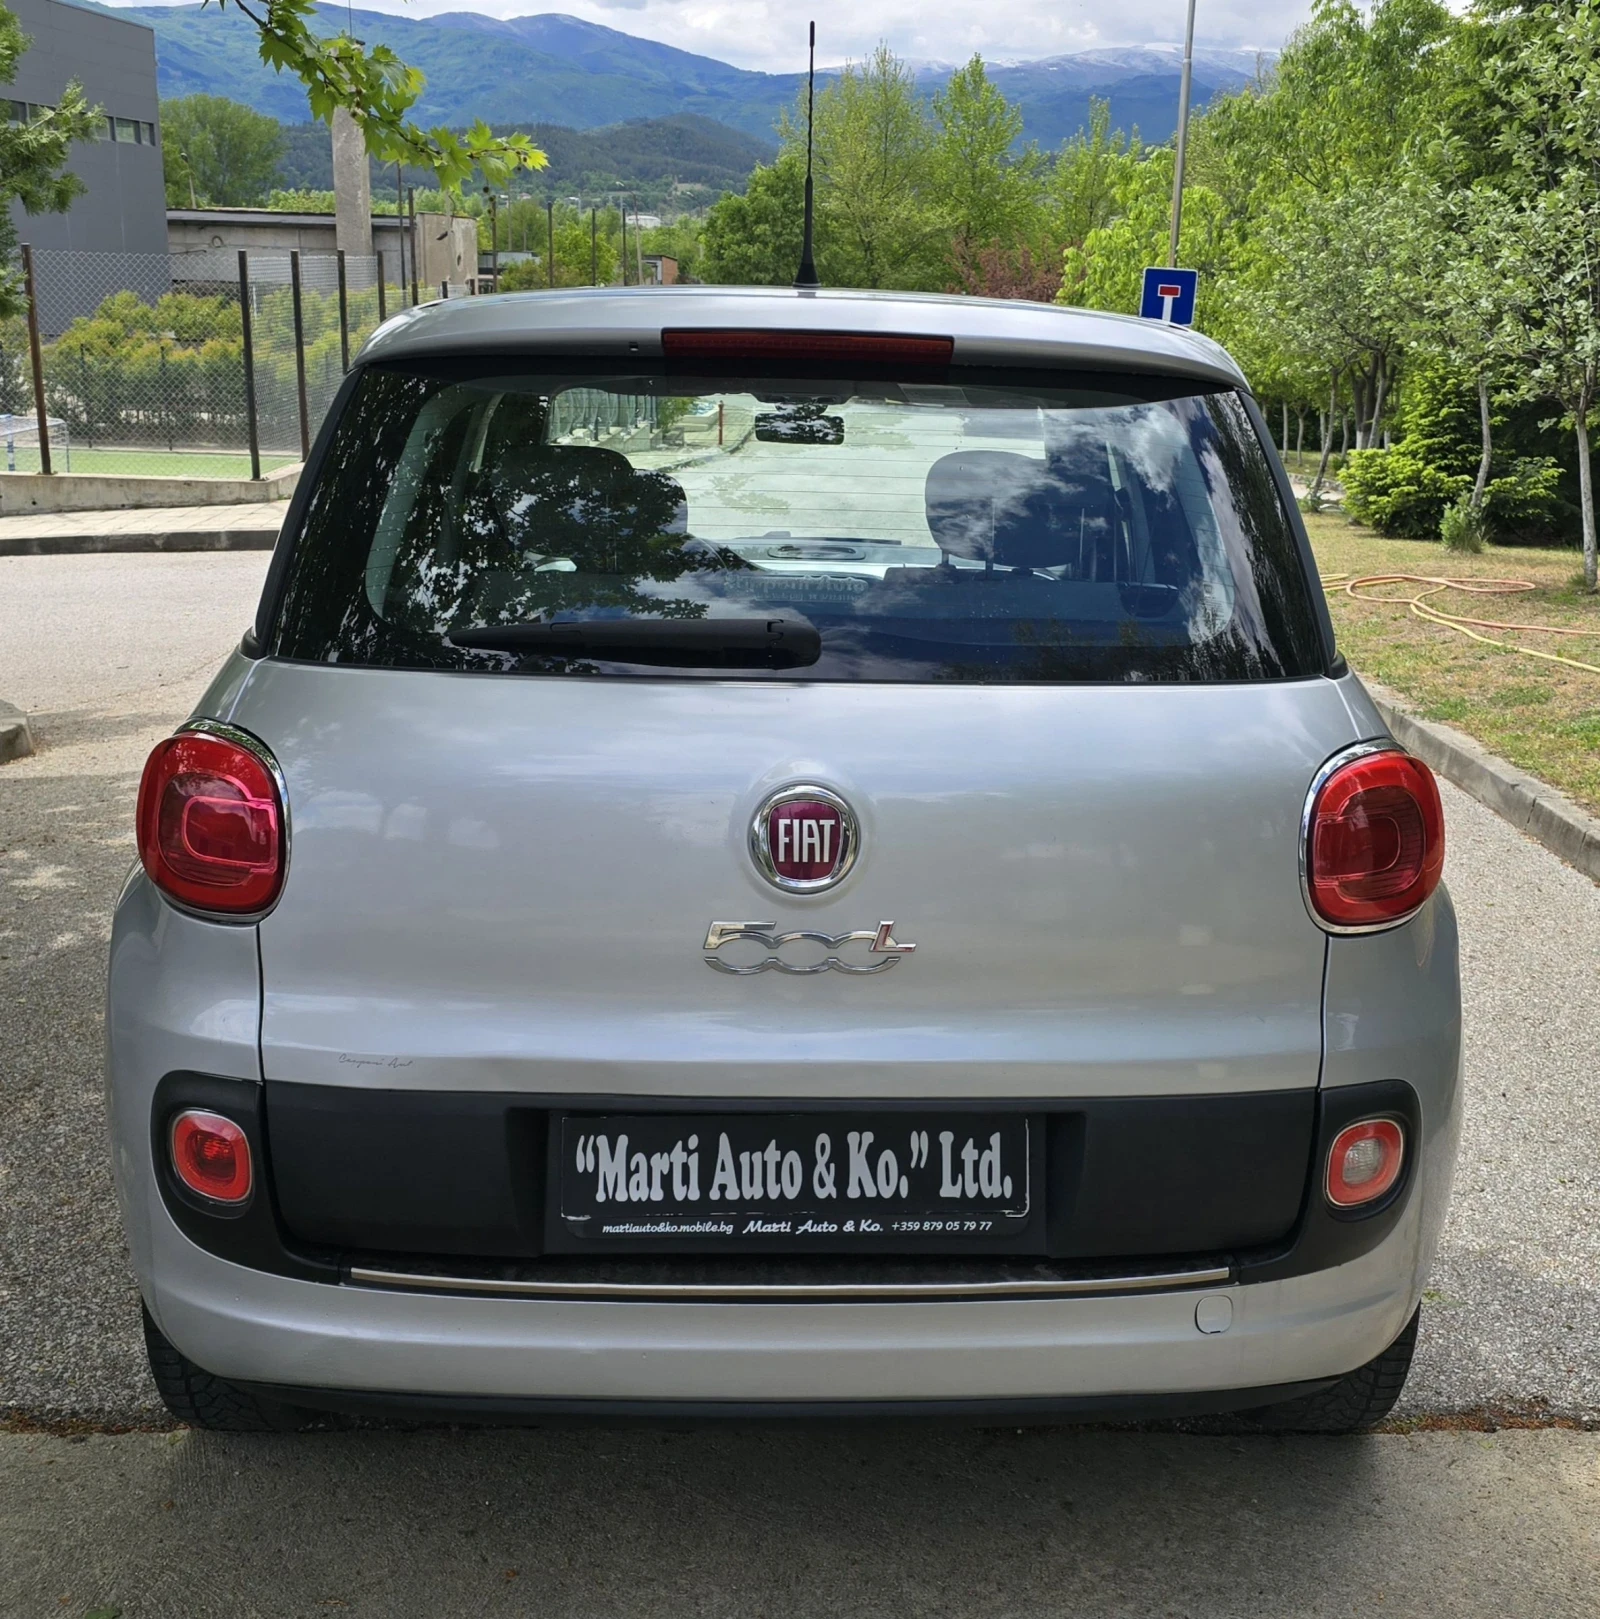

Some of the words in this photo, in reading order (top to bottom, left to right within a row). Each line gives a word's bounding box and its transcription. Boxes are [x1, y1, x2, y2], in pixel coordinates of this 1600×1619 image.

[778, 818, 836, 863] FIAT
[703, 920, 917, 976] 500L
[709, 1132, 803, 1200] Auto
[813, 1133, 837, 1199] &
[939, 1131, 1013, 1199] Ltd.
[602, 1221, 734, 1235] martiauto&ko.mobile.bg
[742, 1220, 792, 1234] Marti
[796, 1220, 838, 1234] Auto
[842, 1220, 856, 1233] &
[859, 1219, 884, 1232] Ko.
[891, 1221, 920, 1231] +359
[922, 1221, 943, 1231] 879
[945, 1221, 961, 1231] 05
[963, 1221, 977, 1231] 79
[978, 1221, 993, 1231] 77
